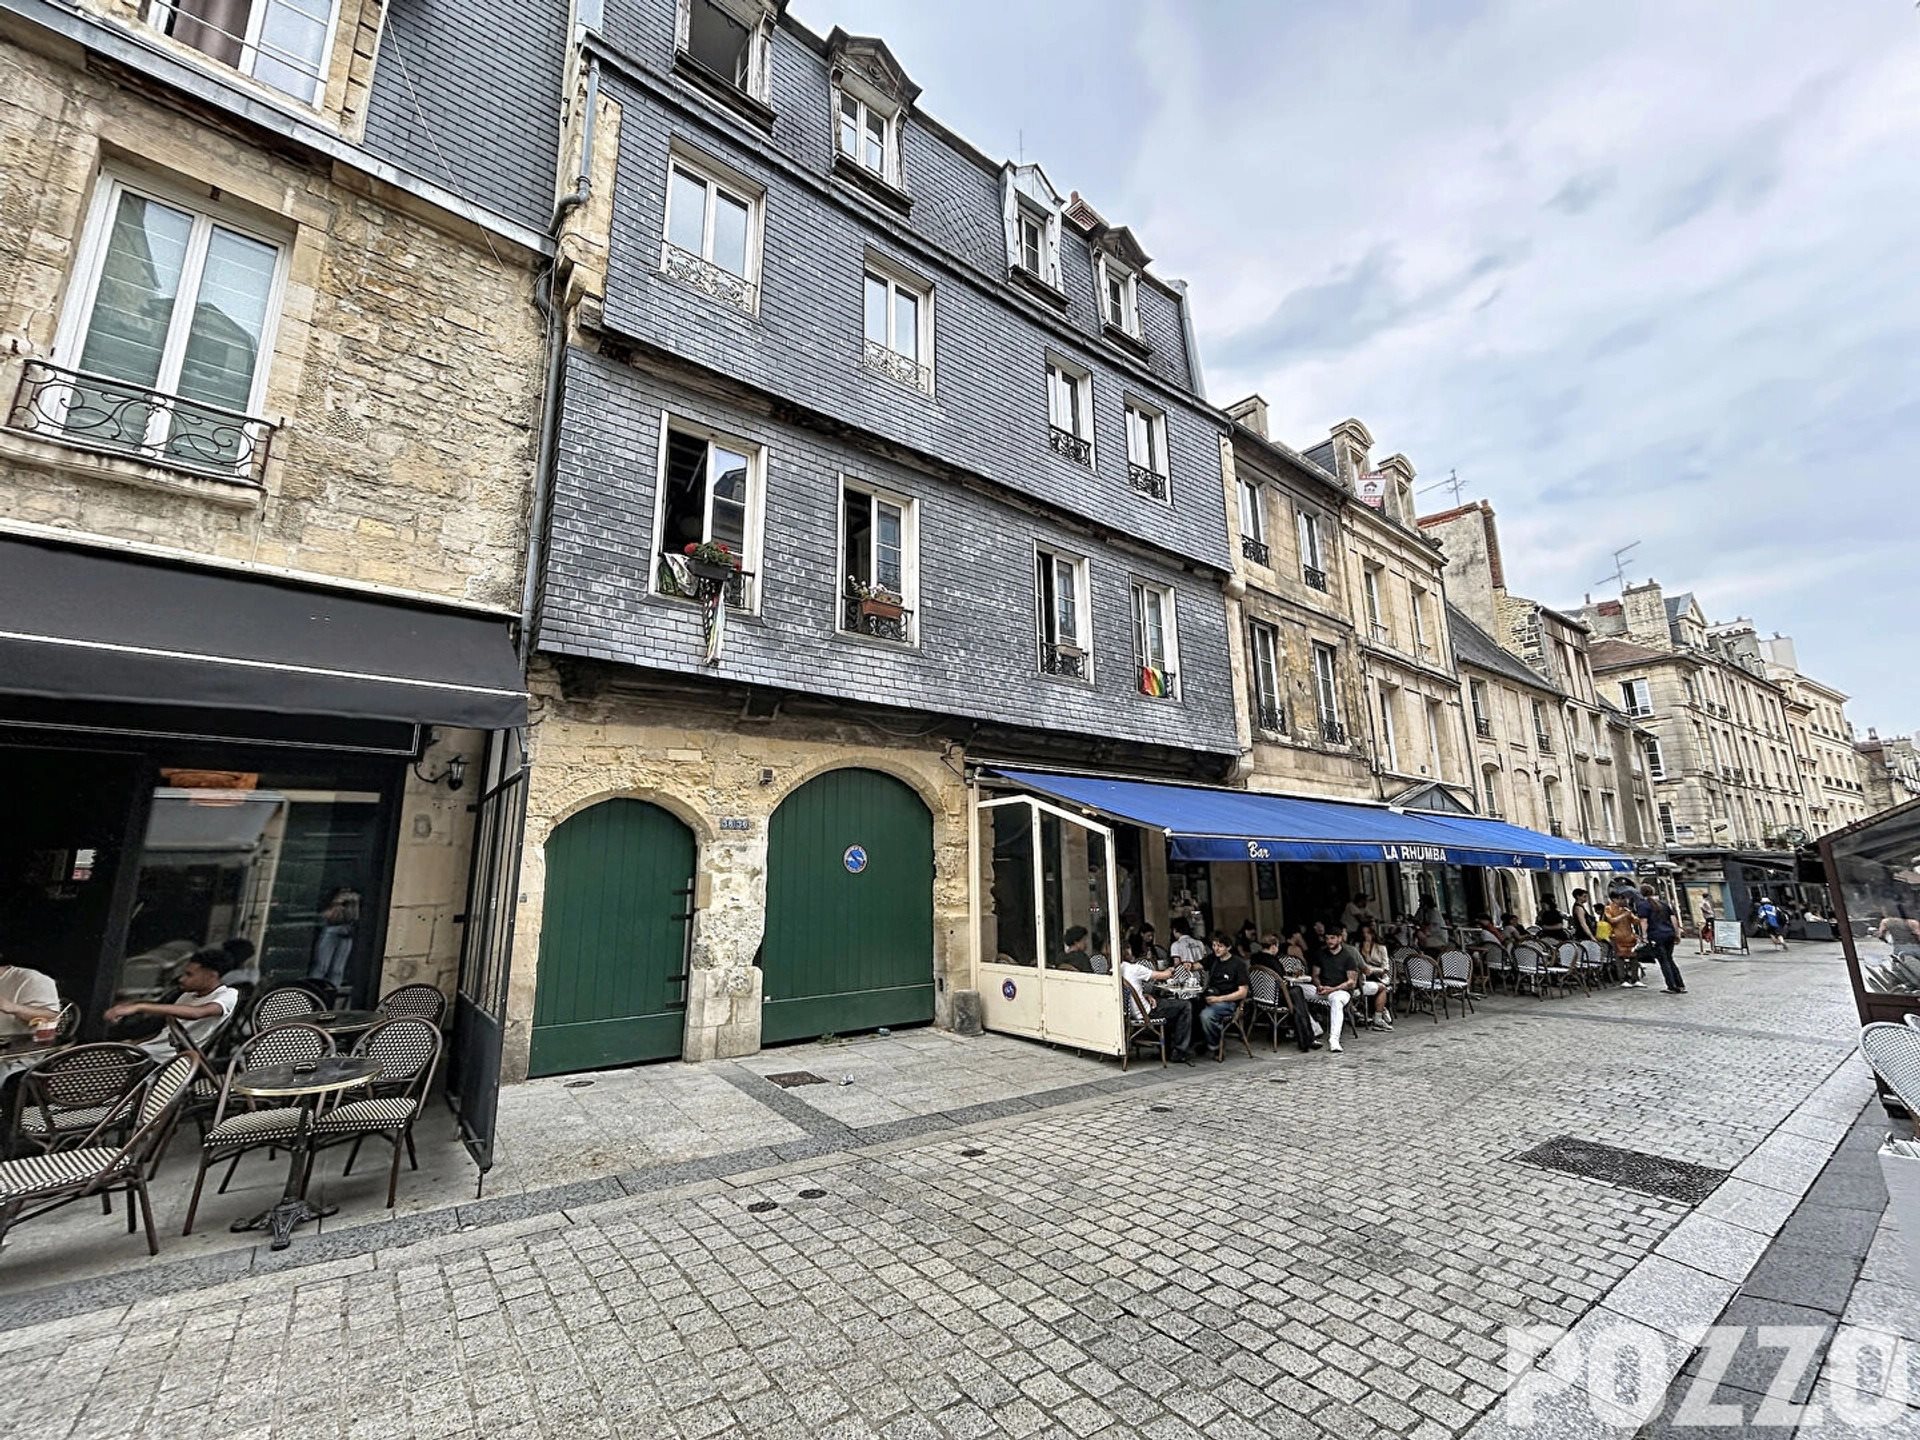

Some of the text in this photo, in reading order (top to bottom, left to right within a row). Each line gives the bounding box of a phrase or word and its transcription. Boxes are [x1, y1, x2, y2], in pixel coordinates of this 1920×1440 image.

[1248, 841, 1270, 858] Bar
[1383, 845, 1447, 862] LA RHUMBA
